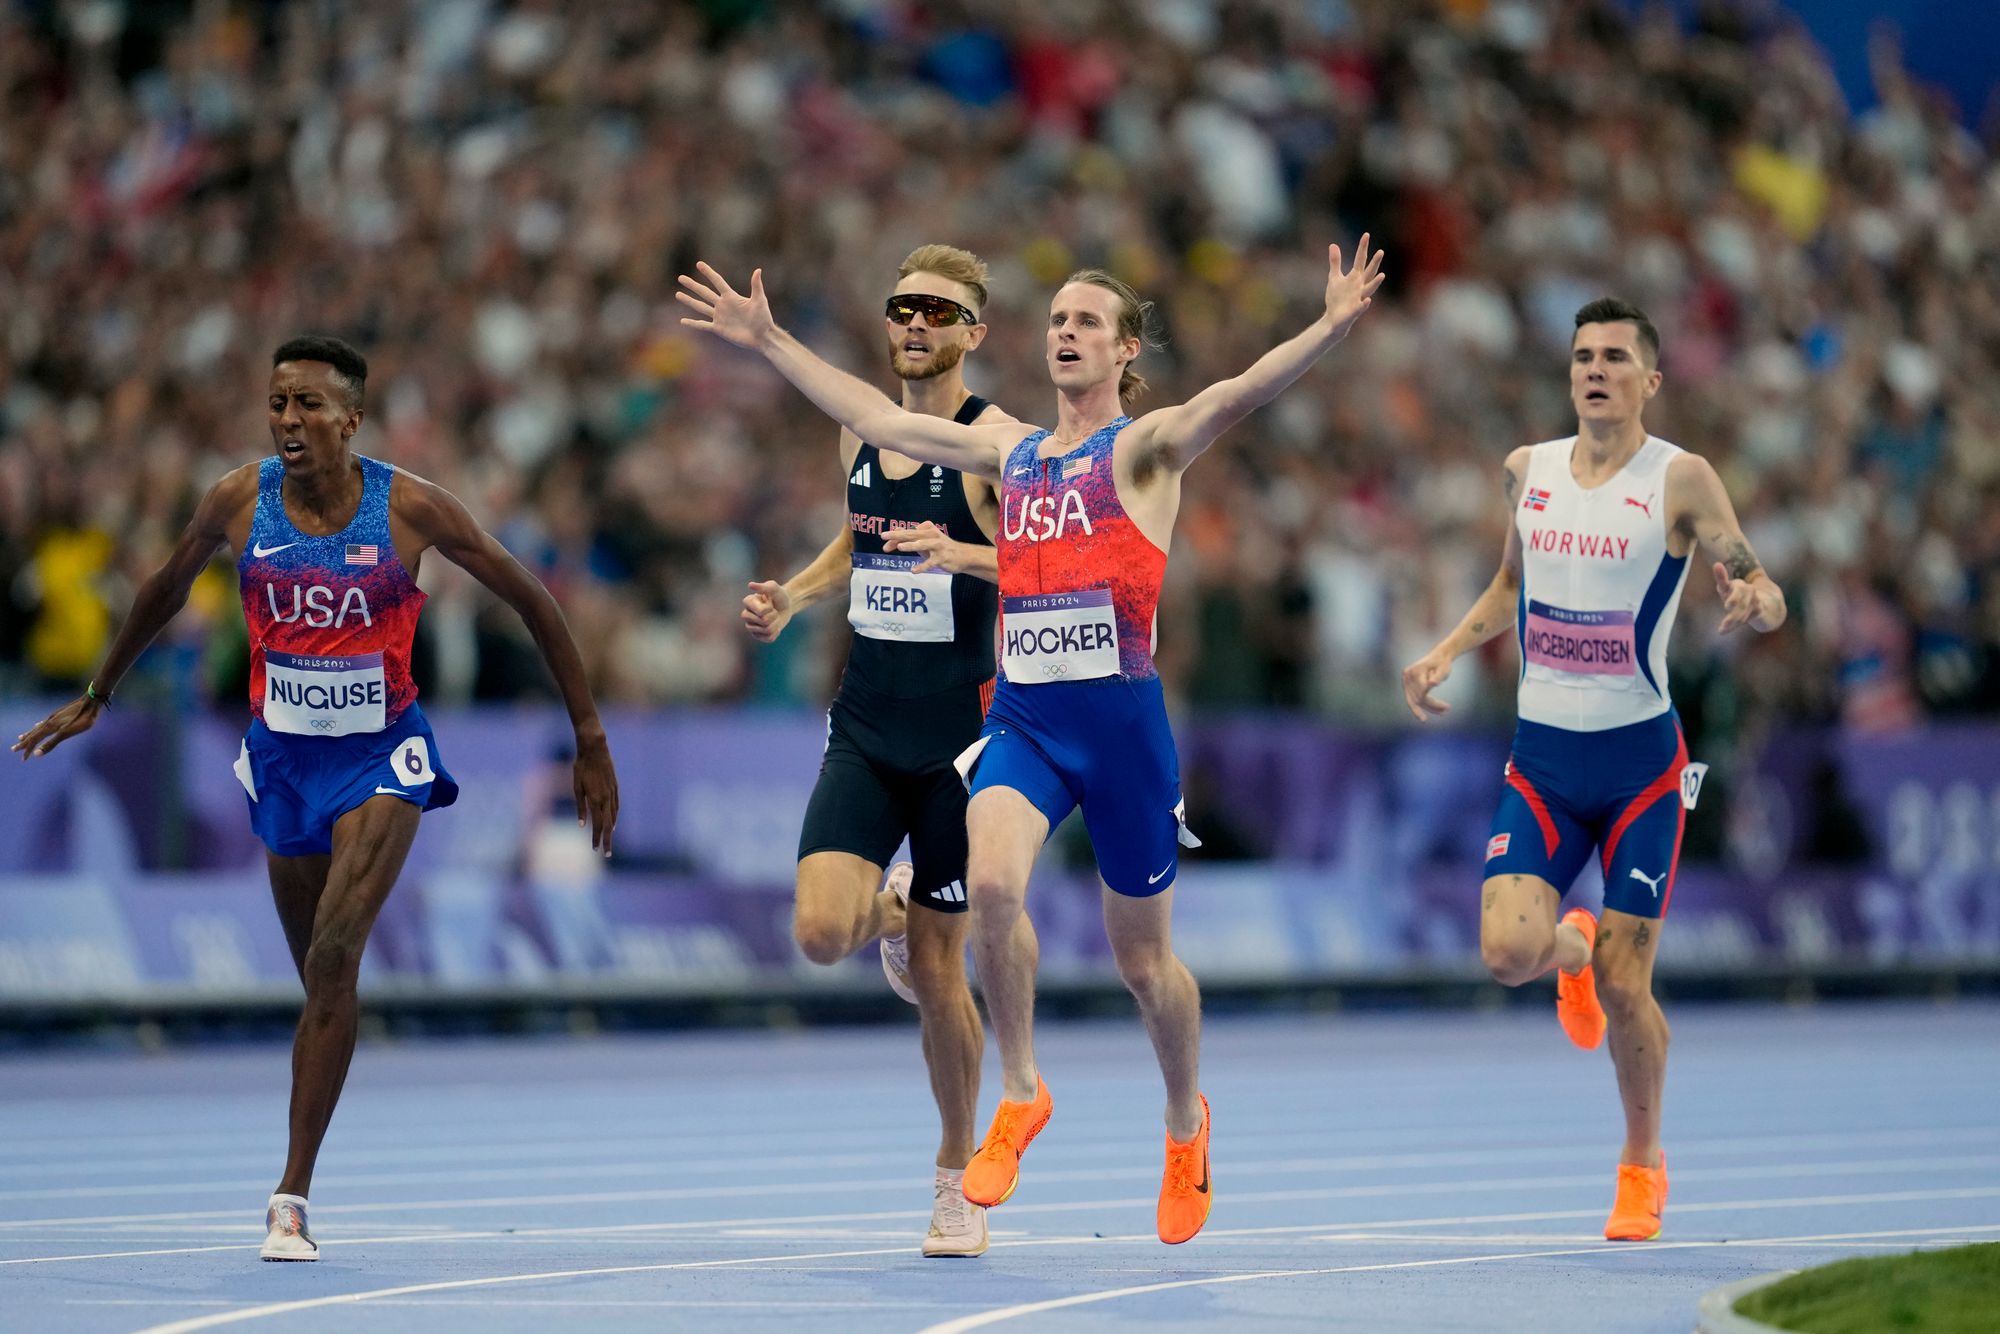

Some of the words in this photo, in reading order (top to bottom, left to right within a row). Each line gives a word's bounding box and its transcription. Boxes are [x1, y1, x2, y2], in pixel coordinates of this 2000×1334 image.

[1004, 489, 1093, 542] USA
[1530, 529, 1629, 561] NORWAY
[872, 558, 895, 567] PARIS
[898, 559, 919, 568] 202
[267, 583, 373, 629] USA
[866, 585, 928, 614] KERR
[1022, 599, 1048, 609] PARIS
[1051, 597, 1079, 607] 2024
[1549, 608, 1575, 621] PARIS
[1577, 613, 1604, 623] 2024
[1007, 623, 1114, 657] HOCKER
[1528, 627, 1630, 664] INGEBRIGTSEN
[291, 658, 321, 668] PARIS
[323, 660, 351, 668] 2024
[271, 676, 382, 710] NUGUSE
[405, 748, 423, 775] 6
[1683, 771, 1699, 798] 10
